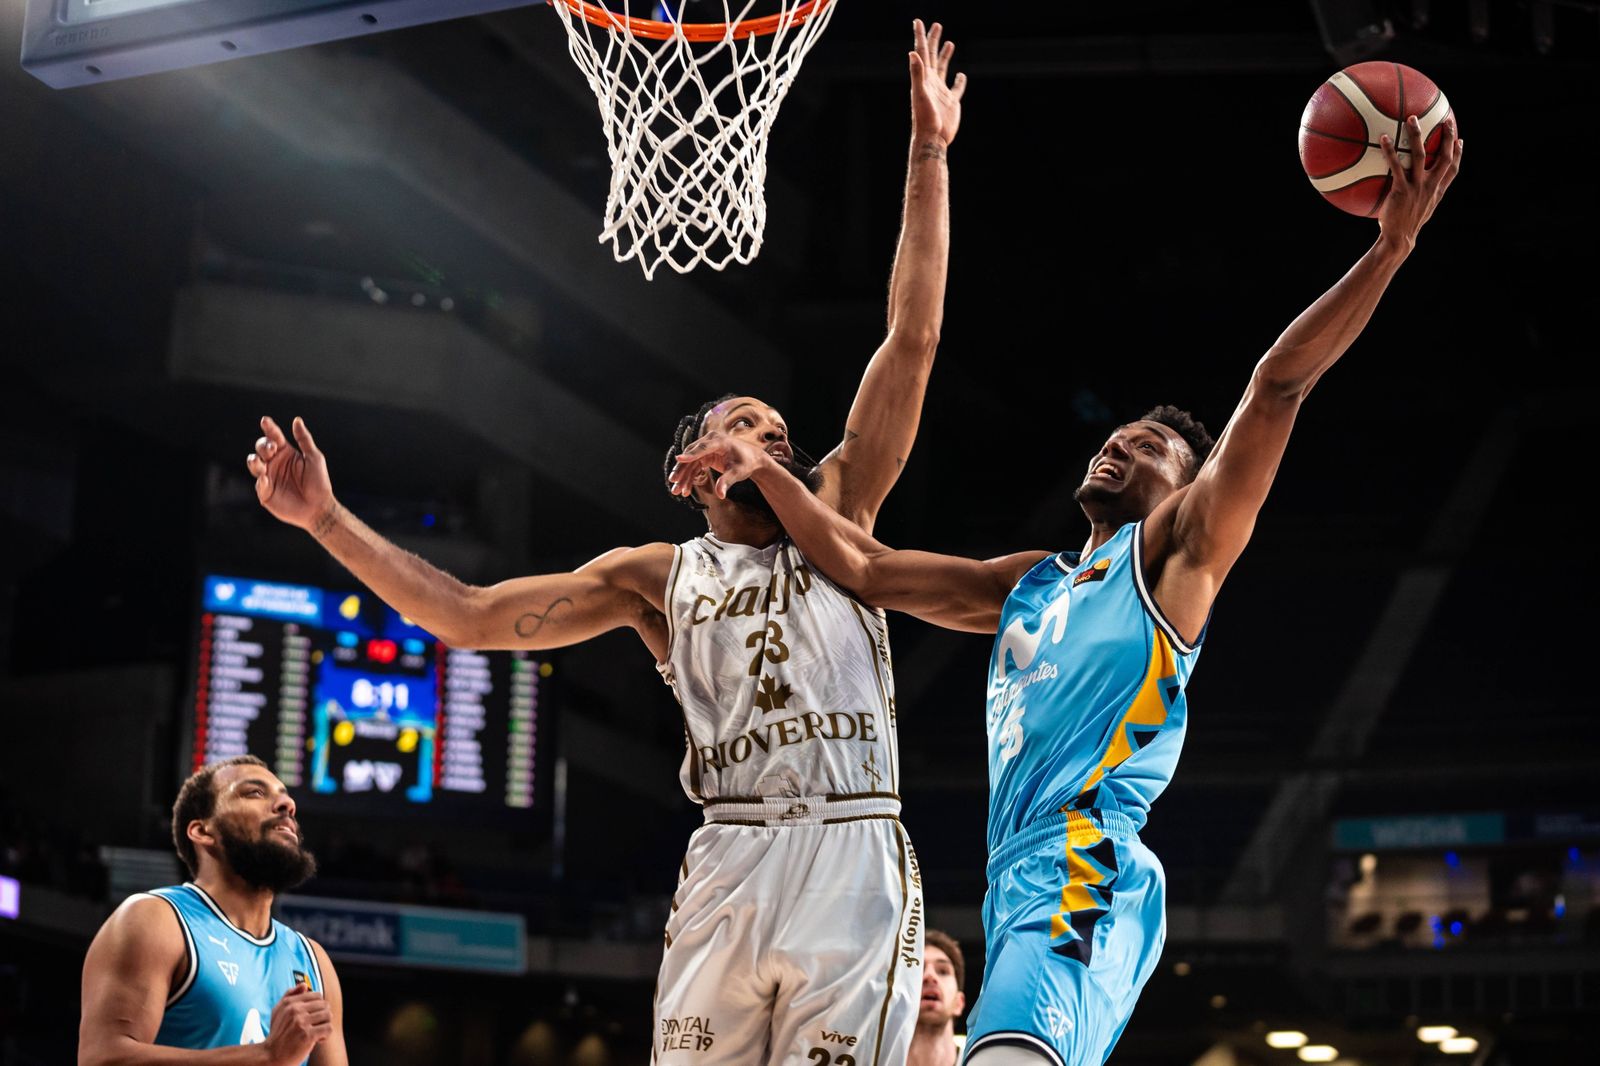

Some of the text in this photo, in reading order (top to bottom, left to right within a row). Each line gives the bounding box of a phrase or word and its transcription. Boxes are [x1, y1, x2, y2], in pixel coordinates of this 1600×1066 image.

[745, 620, 790, 676] 23
[699, 711, 878, 774] RIOVERDE
[820, 1030, 858, 1047] vive
